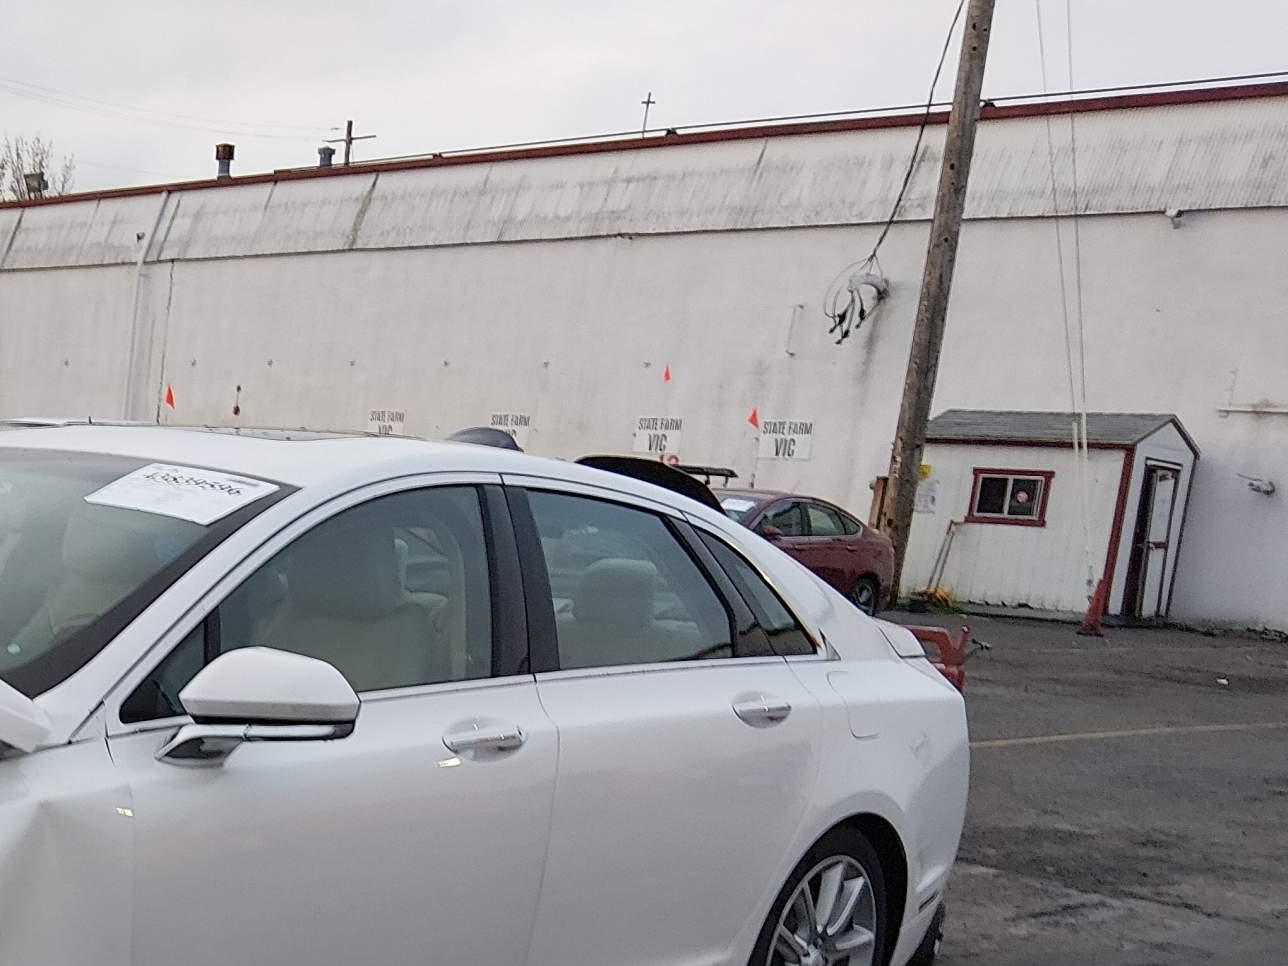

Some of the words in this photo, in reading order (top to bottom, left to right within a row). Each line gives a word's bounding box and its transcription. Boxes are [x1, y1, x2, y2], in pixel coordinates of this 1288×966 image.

[491, 414, 509, 426] STATE
[511, 415, 530, 427] FARM
[638, 417, 658, 431] STATE
[660, 418, 682, 431] FARM
[763, 421, 786, 435] STATE
[788, 421, 813, 435] FARM
[648, 433, 668, 452] VIC
[774, 438, 796, 457] VIC
